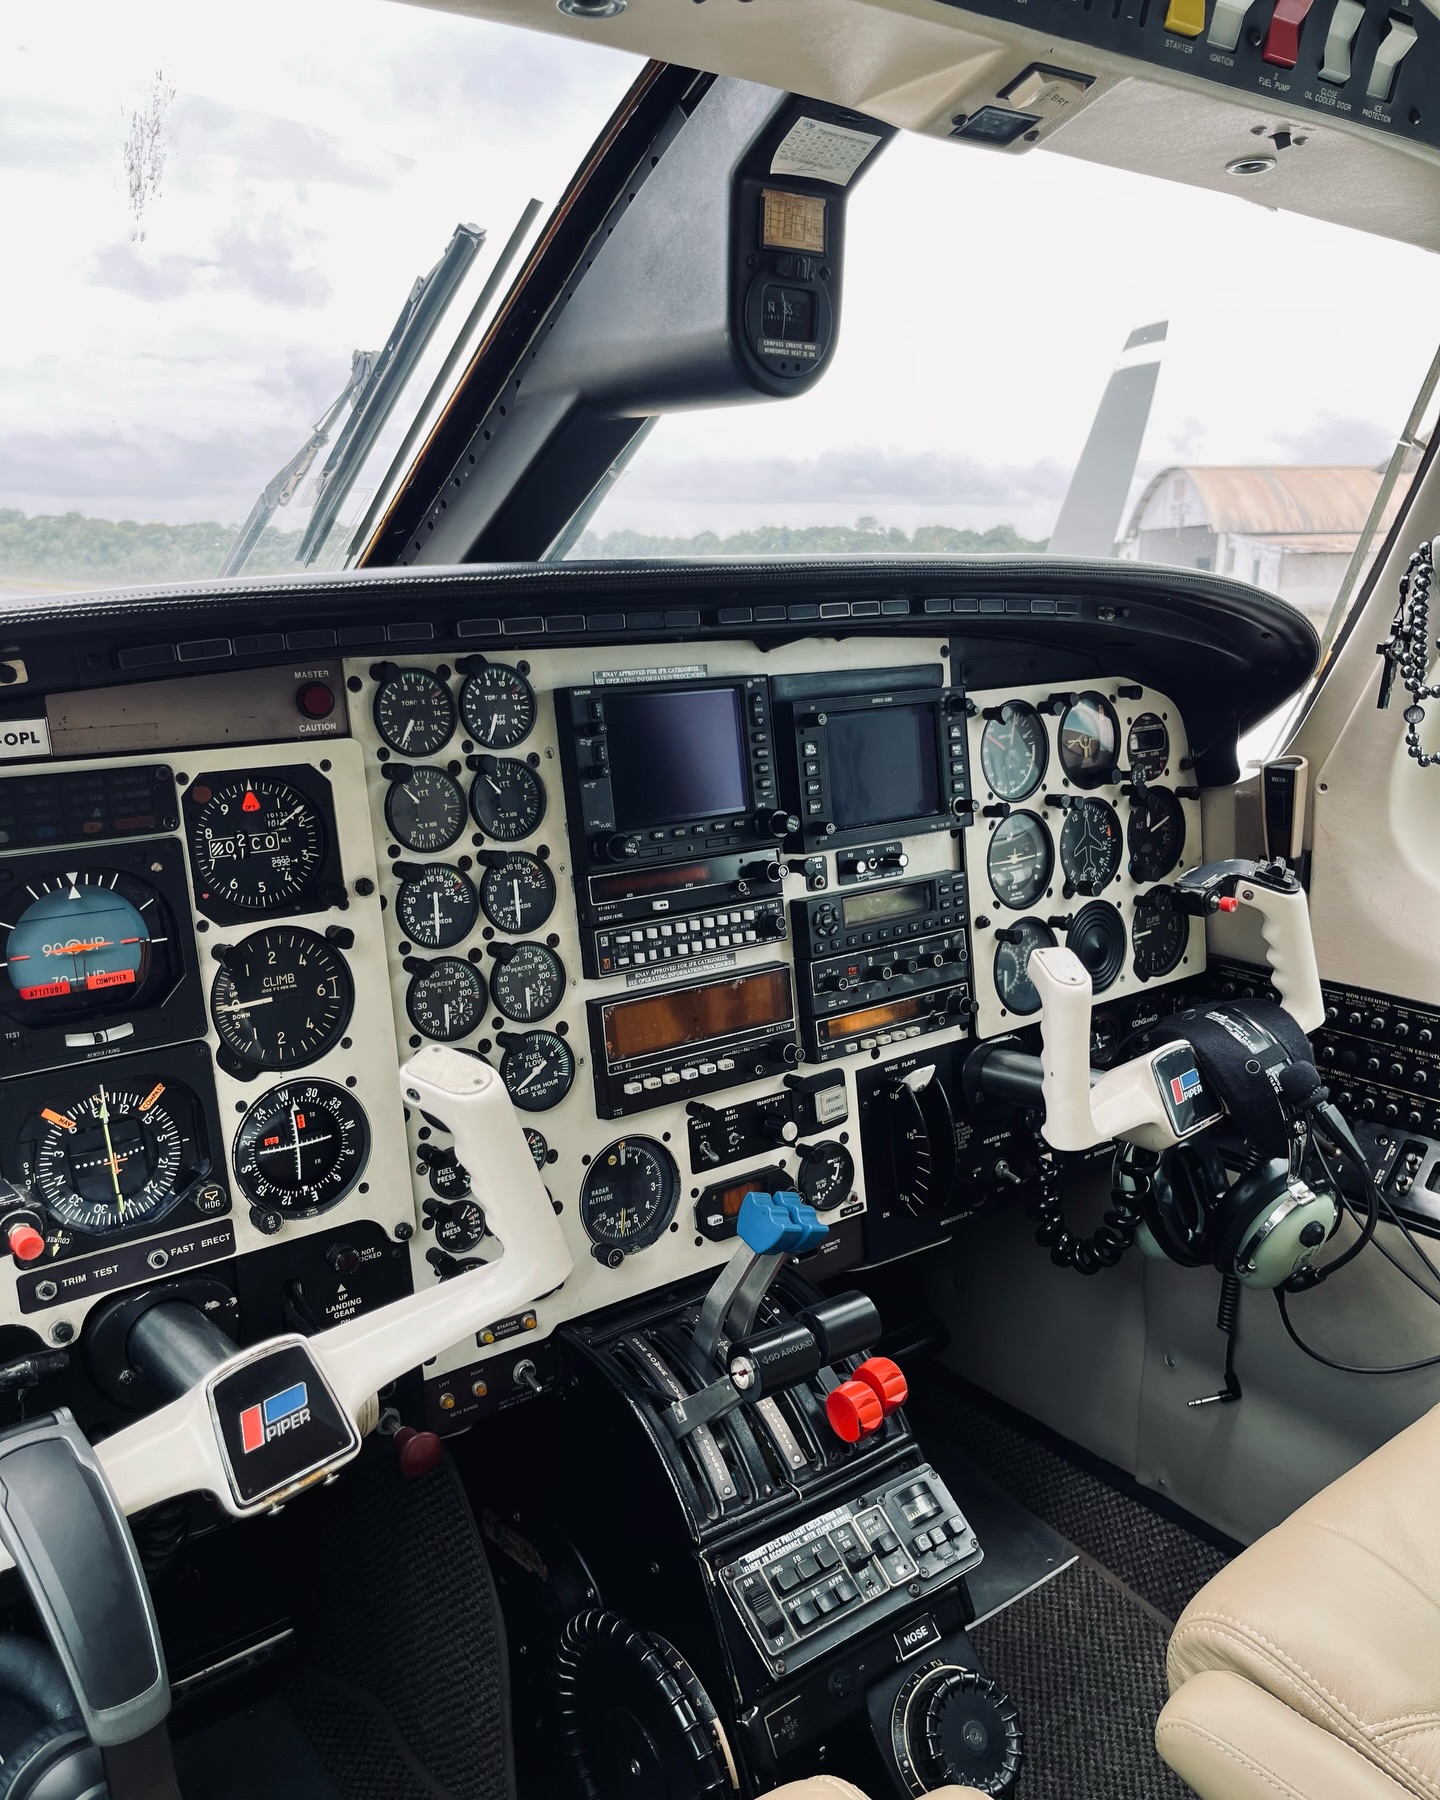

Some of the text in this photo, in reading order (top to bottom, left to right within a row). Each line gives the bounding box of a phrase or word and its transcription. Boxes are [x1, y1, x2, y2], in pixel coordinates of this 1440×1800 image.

[1165, 38, 1193, 55] STARTER
[1210, 53, 1235, 68] IGNITION
[1258, 77, 1291, 92] FUEL PUMP
[1320, 88, 1338, 99] CLOSE
[1051, 94, 1070, 108] BRT
[1304, 91, 1352, 112] OIL COOLER DOOR
[1374, 104, 1383, 113] ICE
[1362, 109, 1391, 124] PROTECTION
[763, 339, 784, 348] COMPASS
[785, 342, 803, 350] ERRATIC
[294, 670, 330, 679] MASTER
[619, 669, 646, 677] APPROVED
[606, 676, 636, 684] OPERATING
[637, 674, 673, 683] INFORMATION
[299, 722, 337, 732] CAUTION
[220, 804, 229, 815] 9
[298, 816, 305, 827] 2
[205, 828, 213, 839] 8
[301, 849, 309, 860] 3
[272, 857, 291, 868] 2992
[284, 871, 293, 881] 4
[230, 878, 238, 890] 6
[258, 881, 266, 893] 5
[268, 951, 277, 965] 2
[299, 954, 307, 966] 4
[510, 964, 536, 974] PERCENT
[635, 971, 650, 979] RNAV
[650, 966, 677, 976] APPROVED
[95, 974, 127, 985] COMPUTER
[263, 973, 295, 988] CLIMB
[538, 972, 550, 980] 100
[638, 974, 668, 984] OPERATING
[668, 966, 703, 978] INFORMATION
[429, 979, 457, 989] PERCENT
[29, 985, 64, 998] ATTITUDE
[317, 984, 326, 996] 6
[459, 988, 472, 996] 100
[1346, 992, 1359, 1000] NON
[1360, 995, 1391, 1007] ESSENTIAL
[232, 1012, 251, 1020] DOWN
[306, 1017, 314, 1029] 4
[5, 1031, 20, 1039] TEST
[277, 1031, 286, 1045] 2
[525, 1052, 543, 1062] FUEL
[524, 1058, 545, 1069] FLOW
[884, 1059, 917, 1073] WING FLAPS
[1331, 1069, 1351, 1079] ENGINE
[517, 1078, 559, 1096] LBS PER HOUR
[1183, 1083, 1203, 1101] PIPER
[142, 1083, 164, 1110] COMPASS
[306, 1088, 318, 1098] 30
[890, 1092, 899, 1100] UP
[329, 1097, 342, 1109] 33
[756, 1094, 785, 1107] TRANSPONDER
[825, 1094, 842, 1104] GROUND
[119, 1104, 130, 1115] 12
[824, 1105, 845, 1116] CLEARANCE
[59, 1118, 73, 1127] NAV
[725, 1114, 739, 1122] SELECT
[694, 1122, 711, 1130] MASTER
[983, 1131, 1011, 1146] HEATER FUEL
[437, 1167, 454, 1177] FUEL
[437, 1173, 456, 1184] PRESS
[815, 1177, 827, 1185] WING
[591, 1186, 610, 1196] RADAR
[816, 1182, 827, 1190] FLAP
[204, 1200, 221, 1209] HDG
[589, 1193, 614, 1205] ALTITUDE
[267, 1215, 275, 1229] OBS
[940, 1212, 968, 1226] WINDSHIELD
[444, 1221, 456, 1230] OIL
[442, 1226, 461, 1238] PRESS
[46, 1236, 71, 1245] COURSE
[170, 1232, 231, 1257] FAST ERECT
[820, 1238, 841, 1250] ALTERNATE
[361, 1247, 375, 1256] NOT
[823, 1245, 838, 1254] SOURCE
[61, 1264, 119, 1288] TRIM TEST
[338, 1293, 348, 1301] UP
[325, 1297, 362, 1314] LANDING
[333, 1307, 356, 1319] GEAR
[497, 1320, 517, 1330] STARTER
[494, 1325, 520, 1337] ENERGIZED
[768, 1339, 814, 1362] GO AROUND
[471, 1368, 484, 1376] RIGHT
[439, 1381, 450, 1389] LEFT
[450, 1404, 479, 1418] BETA RANGE
[266, 1407, 311, 1442] PIPER
[703, 1439, 725, 1481] REVERSE
[861, 1517, 875, 1528] YAW
[837, 1529, 845, 1539] AP
[864, 1523, 882, 1536] DAMP
[745, 1549, 769, 1564] CONDUCT
[780, 1527, 807, 1545] PREFLIGHT
[806, 1519, 822, 1531] CHECK
[821, 1511, 838, 1522] PRIOR
[836, 1507, 843, 1516] TO
[743, 1560, 761, 1573] FLIGHT
[769, 1539, 802, 1561] ACCORDANCE
[802, 1531, 817, 1542] WITH
[816, 1522, 833, 1535] FLIGHT
[811, 1543, 823, 1555] ALT
[792, 1554, 802, 1564] FD
[771, 1565, 784, 1576] HDG
[858, 1569, 869, 1580] OFF
[828, 1575, 844, 1588] APPR
[810, 1587, 820, 1597] BC
[866, 1586, 882, 1599] TEST
[788, 1598, 801, 1610] NAV
[775, 1636, 784, 1647] UP
[903, 1625, 929, 1647] NOSE
[781, 1719, 800, 1736] NOSE
